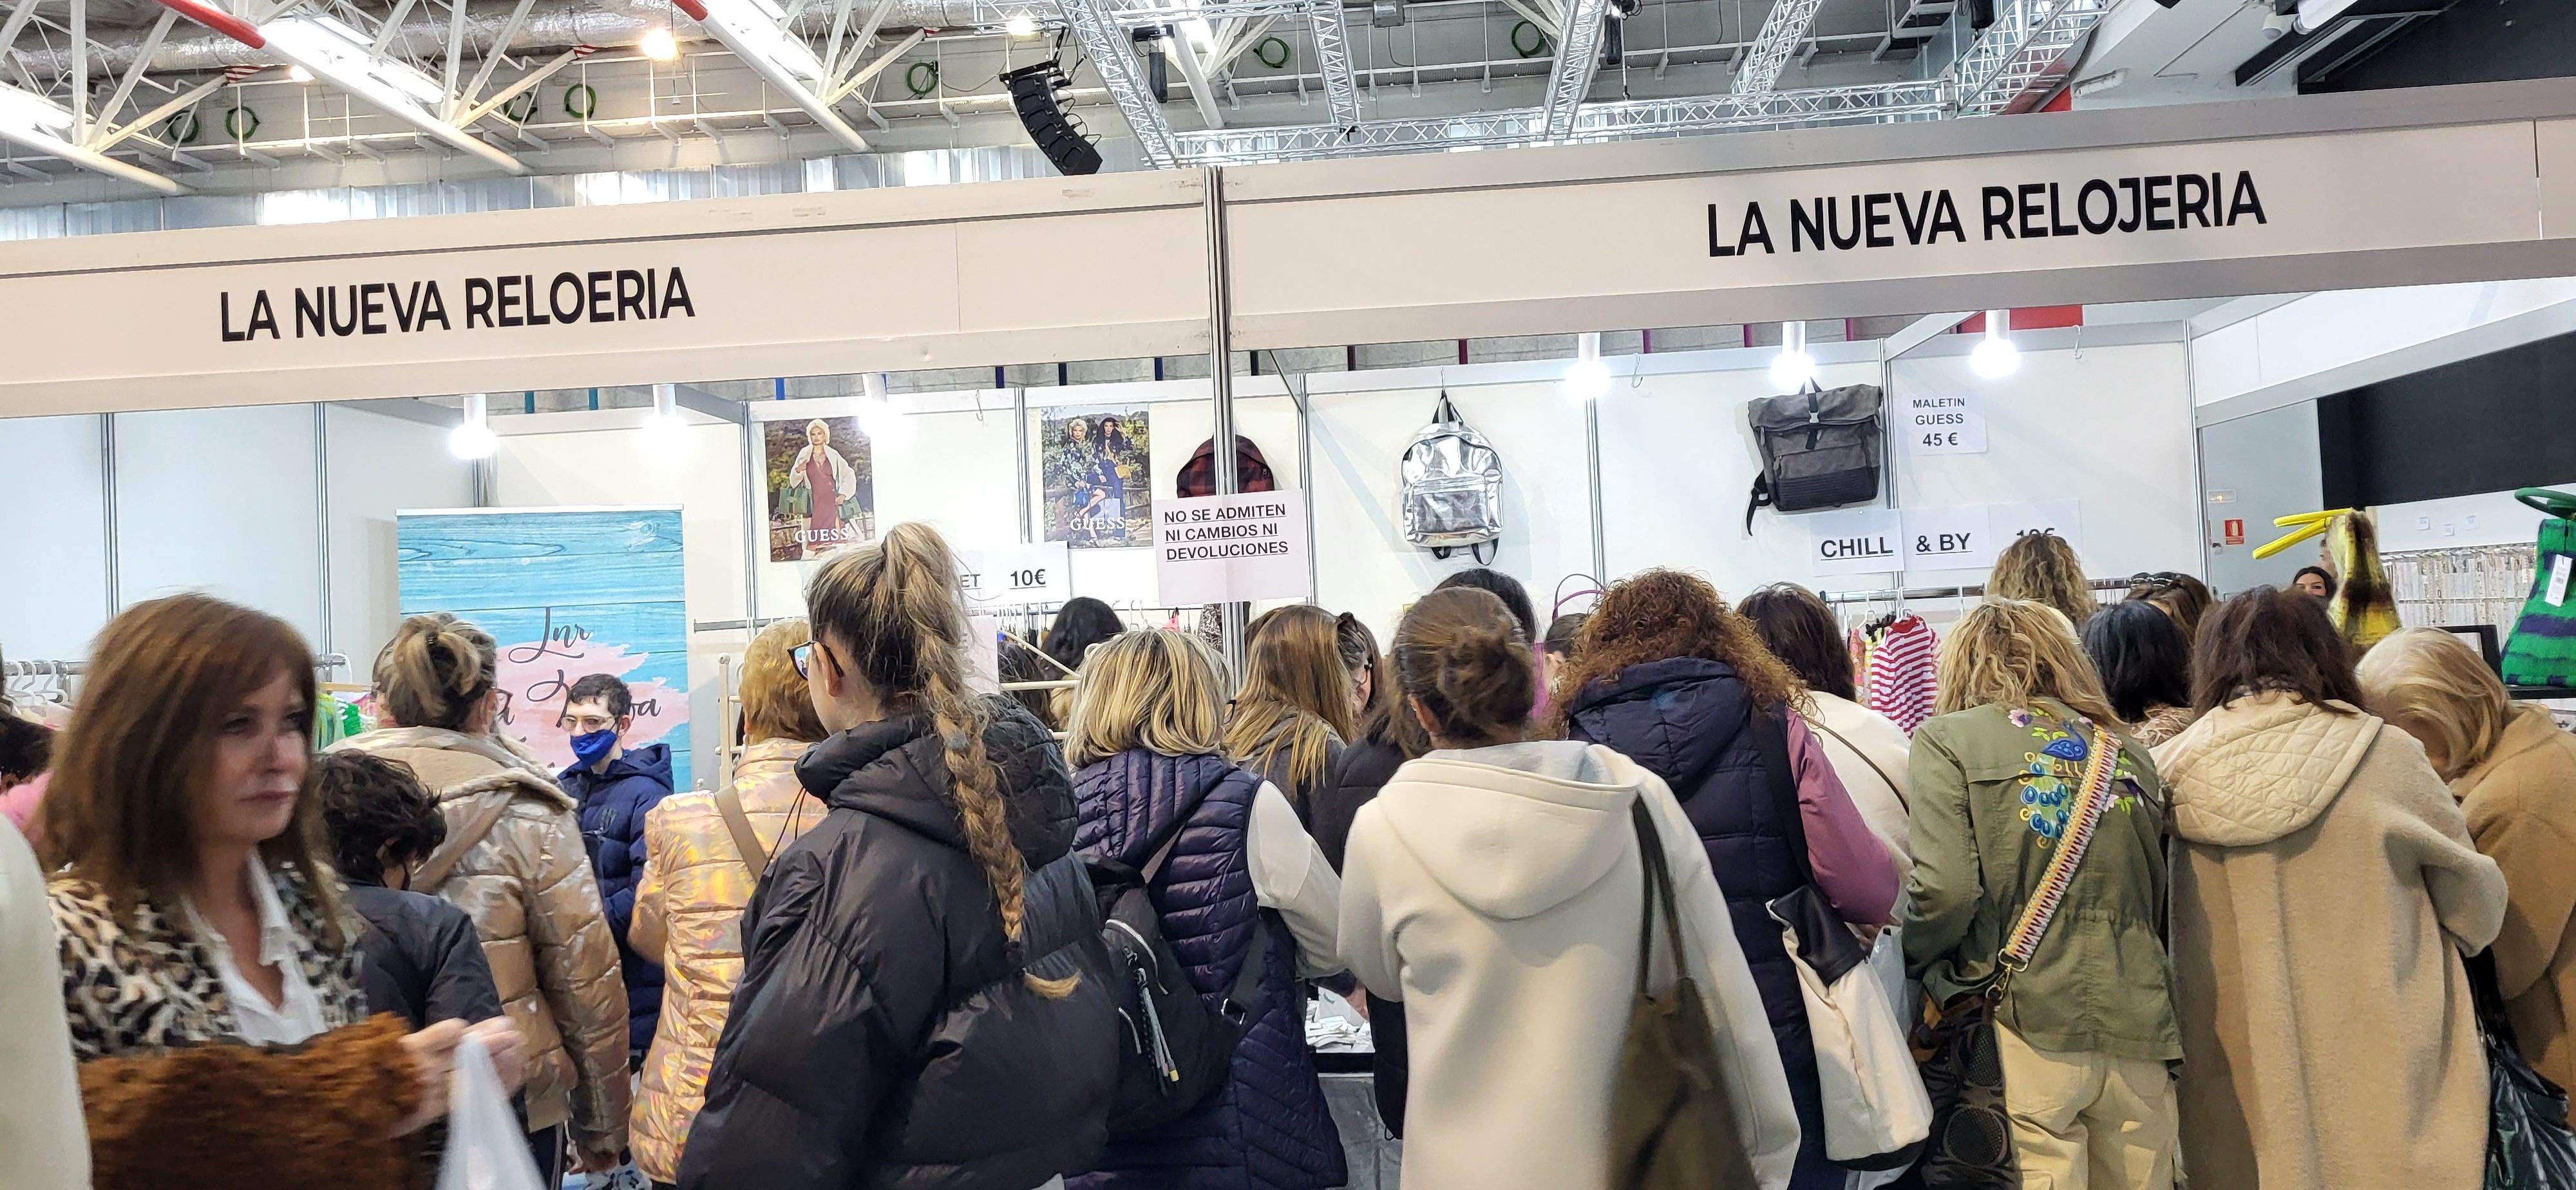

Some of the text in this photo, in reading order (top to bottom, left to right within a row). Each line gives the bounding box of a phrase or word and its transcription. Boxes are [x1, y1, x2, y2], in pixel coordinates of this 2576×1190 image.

[1707, 170, 2268, 258] LA NUEVA RELOJERIA
[220, 267, 696, 342] LA NUEVA RELOERIA
[1913, 398, 1965, 408] MALETIN
[1915, 413, 1964, 425] GUESS
[1922, 432, 1958, 446] 45 €
[1164, 504, 1285, 523] NO SE ADMITEN
[1070, 516, 1125, 531] GUESS
[1165, 522, 1278, 542] NI CAMBIOS NI
[795, 527, 851, 543] GUESS
[1166, 541, 1289, 560] DEVOLUCIONES
[1821, 533, 1971, 558] CHILL & BY
[1010, 569, 1046, 587] 10€
